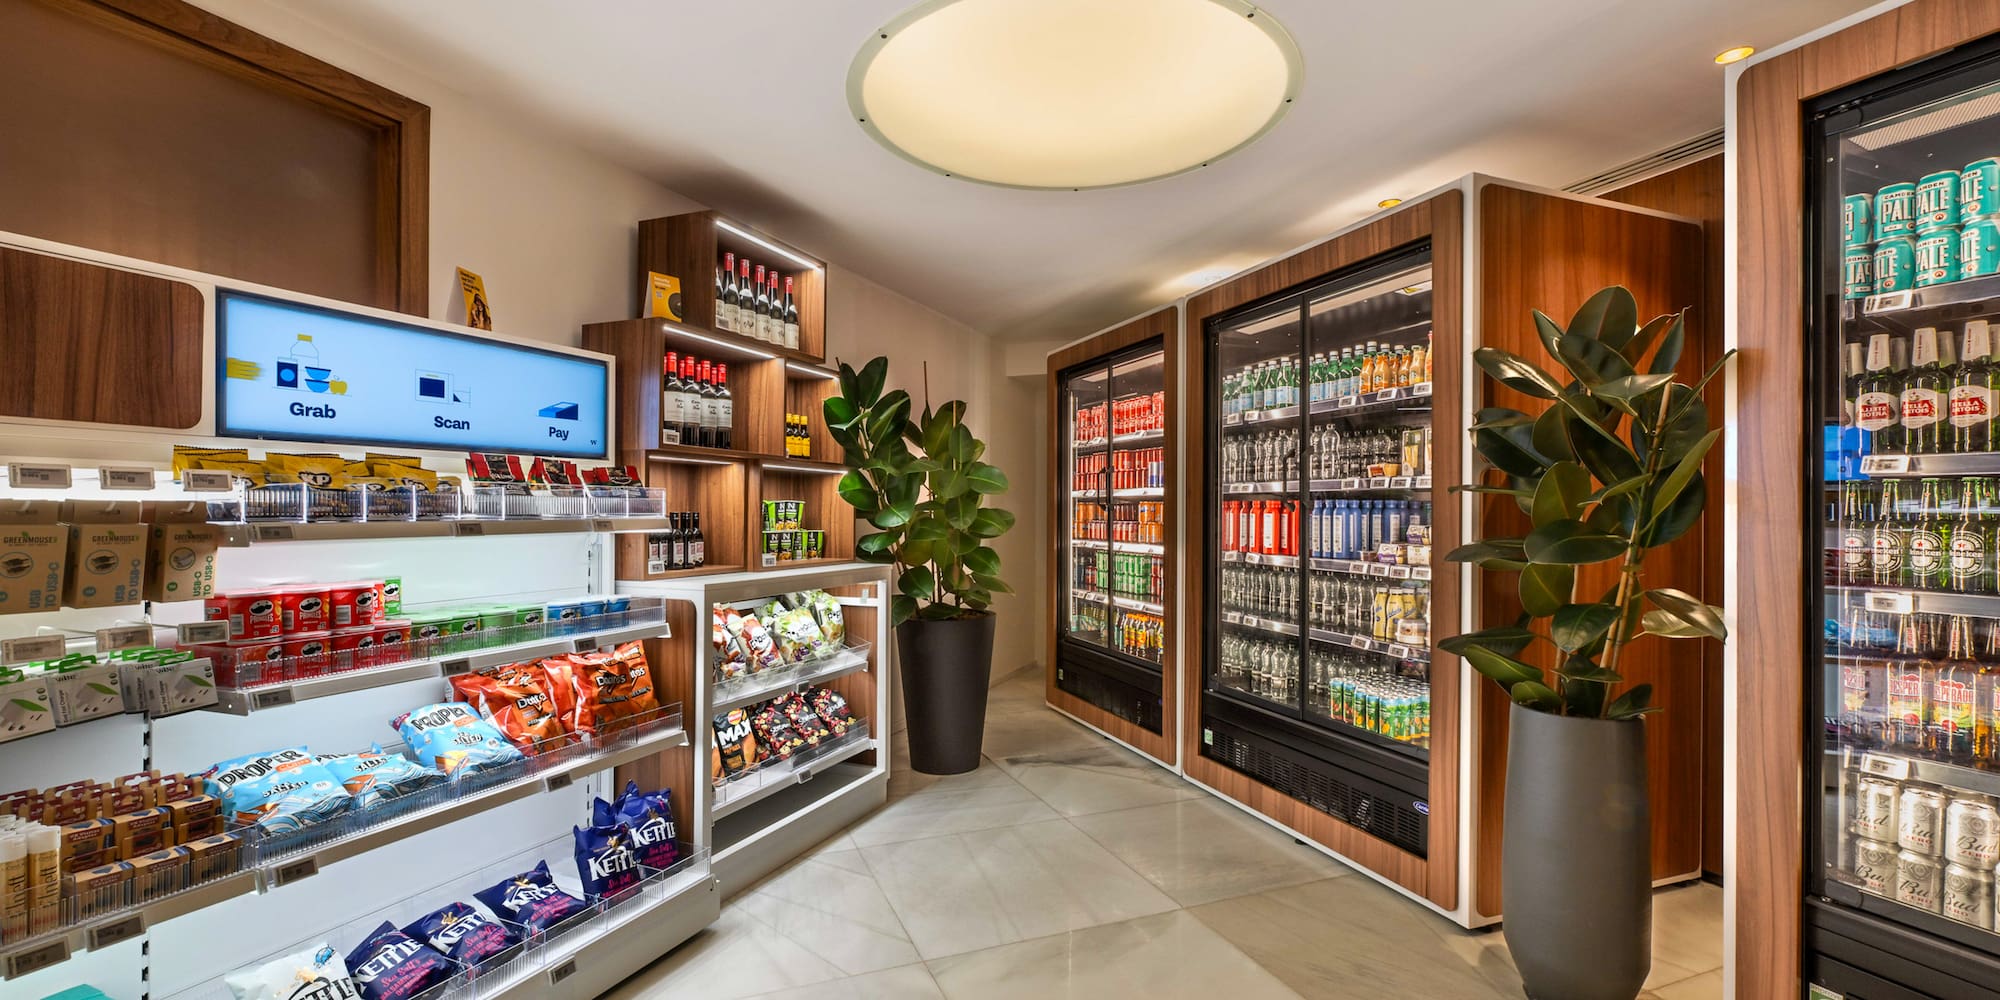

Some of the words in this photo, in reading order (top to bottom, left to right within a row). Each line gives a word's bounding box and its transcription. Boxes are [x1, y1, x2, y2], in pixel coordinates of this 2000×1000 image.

[1882, 198, 1915, 224] PAL
[289, 402, 336, 419] Grab
[433, 415, 470, 431] Scan
[548, 426, 569, 441] Pay
[299, 472, 331, 487] KP
[204, 555, 213, 581] USB-C
[193, 571, 202, 597] USB-C
[203, 584, 212, 596] TO
[717, 718, 752, 746] MAX
[217, 749, 306, 790] PROPER
[1956, 835, 1998, 852] Bud
[381, 973, 397, 988] Sea
[398, 958, 422, 977] Salt's
